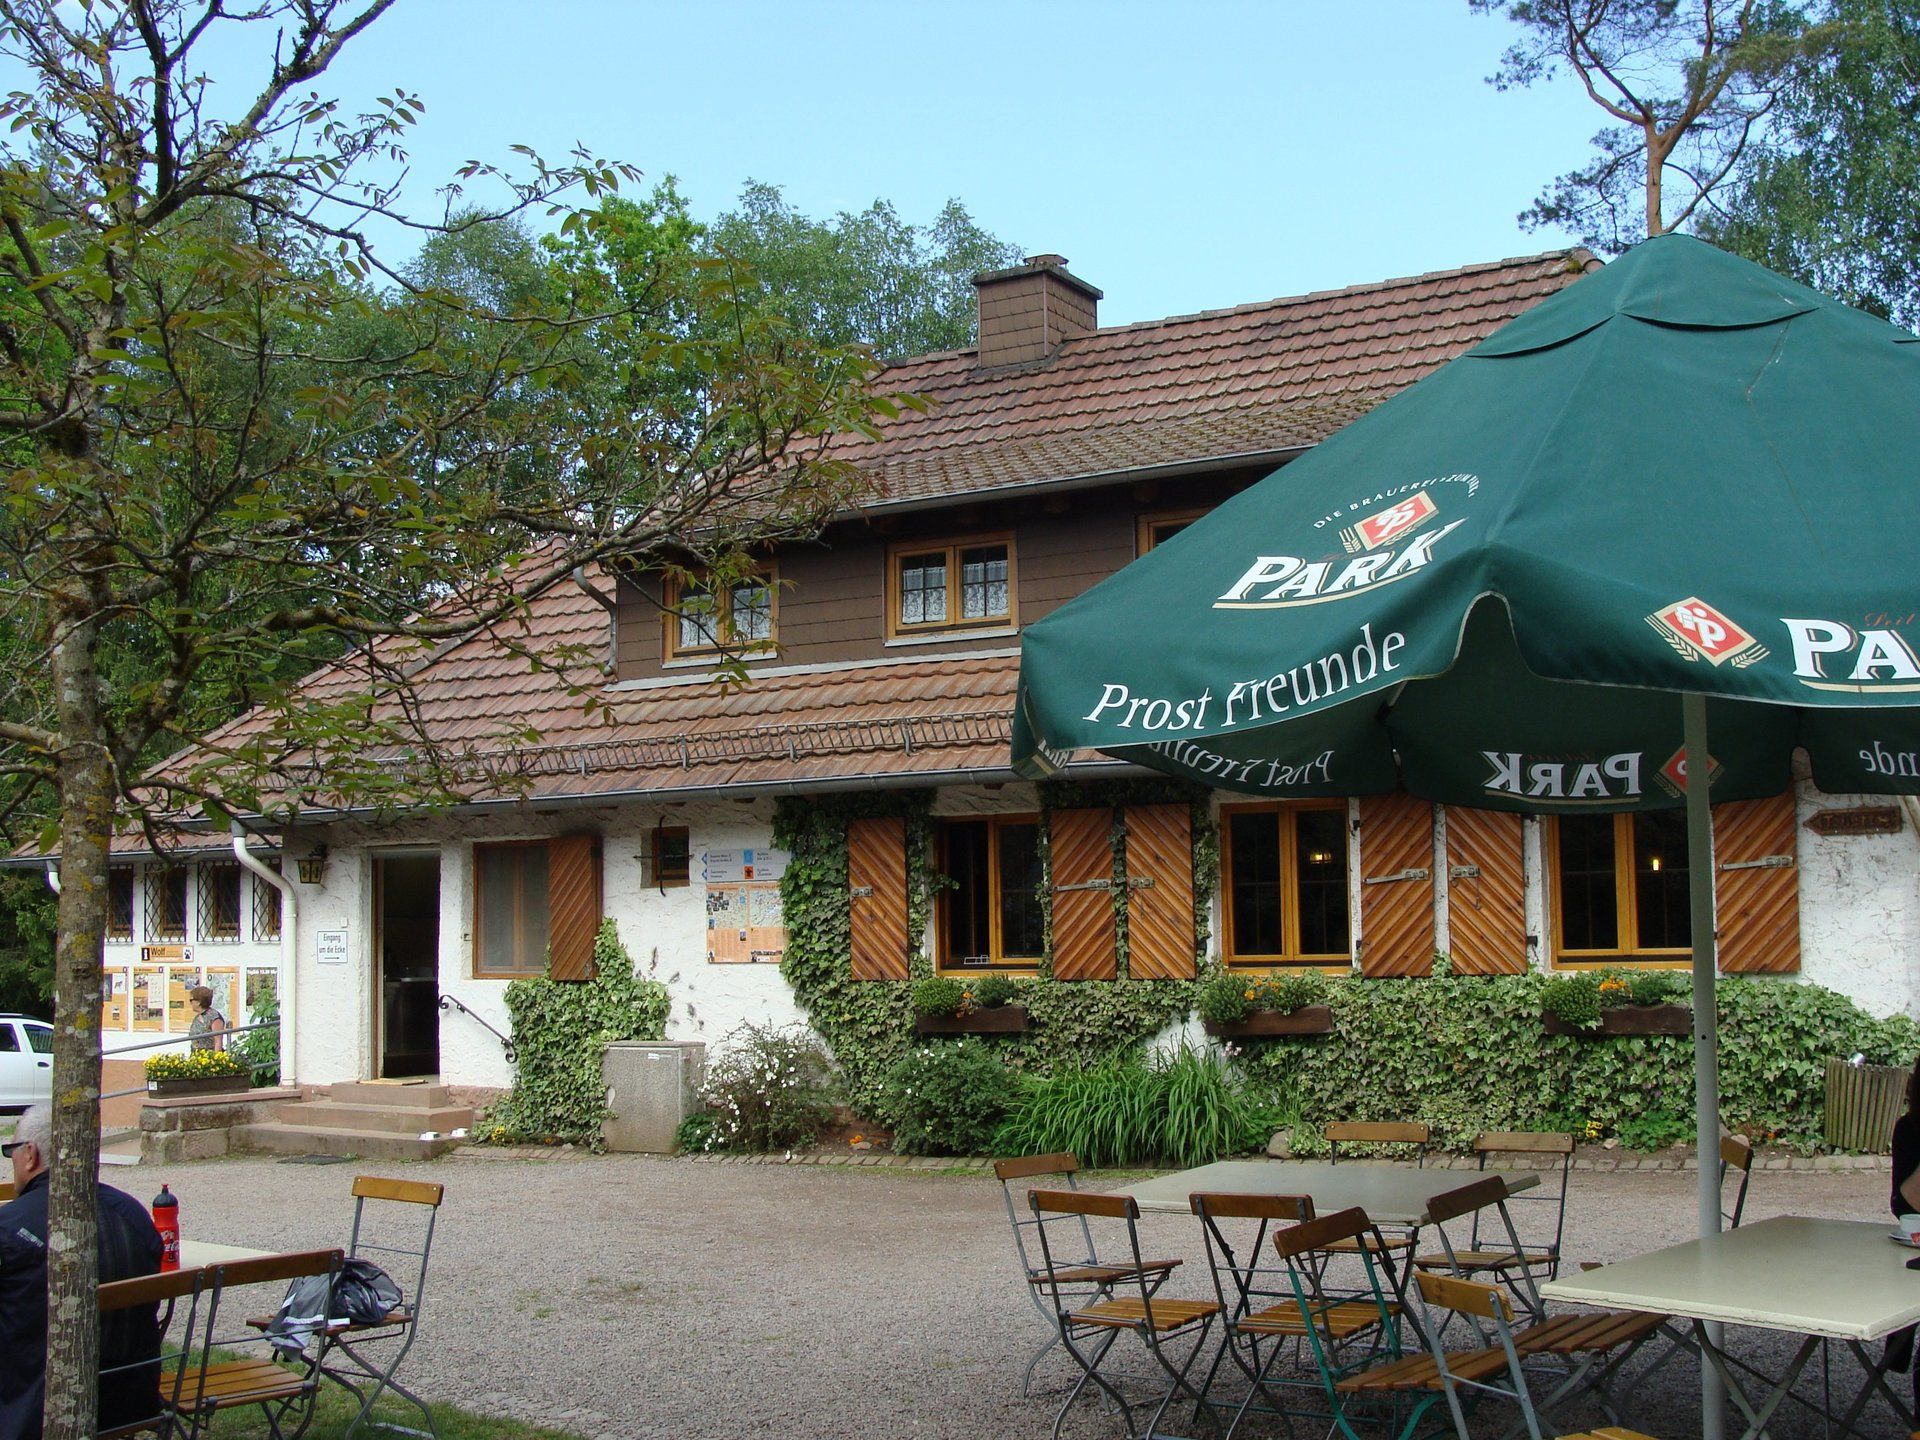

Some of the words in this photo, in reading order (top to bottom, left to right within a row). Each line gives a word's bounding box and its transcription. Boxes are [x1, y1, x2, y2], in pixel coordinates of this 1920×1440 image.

[1313, 510, 1343, 529] DIE
[1350, 478, 1436, 511] BRAUEREI
[1217, 517, 1469, 600] PARK
[1083, 683, 1212, 730] Prost
[1221, 622, 1405, 727] Freunde
